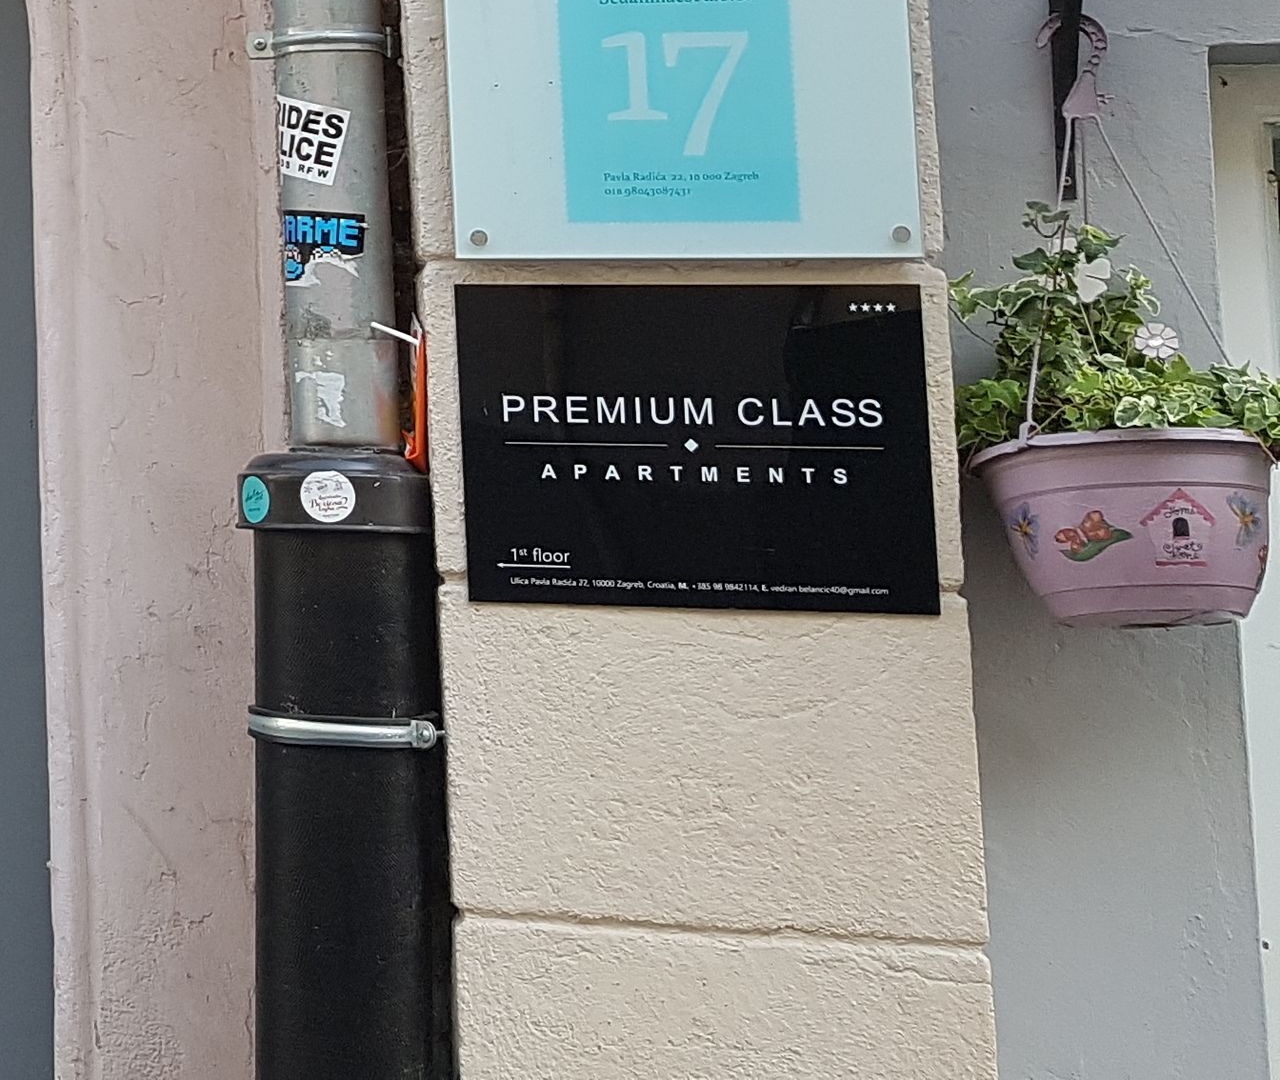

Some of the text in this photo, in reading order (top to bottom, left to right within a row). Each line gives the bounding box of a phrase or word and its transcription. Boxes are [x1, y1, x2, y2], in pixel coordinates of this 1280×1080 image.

[600, 30, 749, 156] 17
[278, 101, 345, 139] IDES
[603, 171, 631, 182] Pavla
[724, 171, 759, 183] Zagreb
[501, 394, 884, 428] PREMIUM CLASS
[541, 463, 849, 485] APARTMENTS
[510, 547, 571, 563] 1st floor
[510, 576, 529, 585] Ulica
[592, 579, 615, 588] 10000
